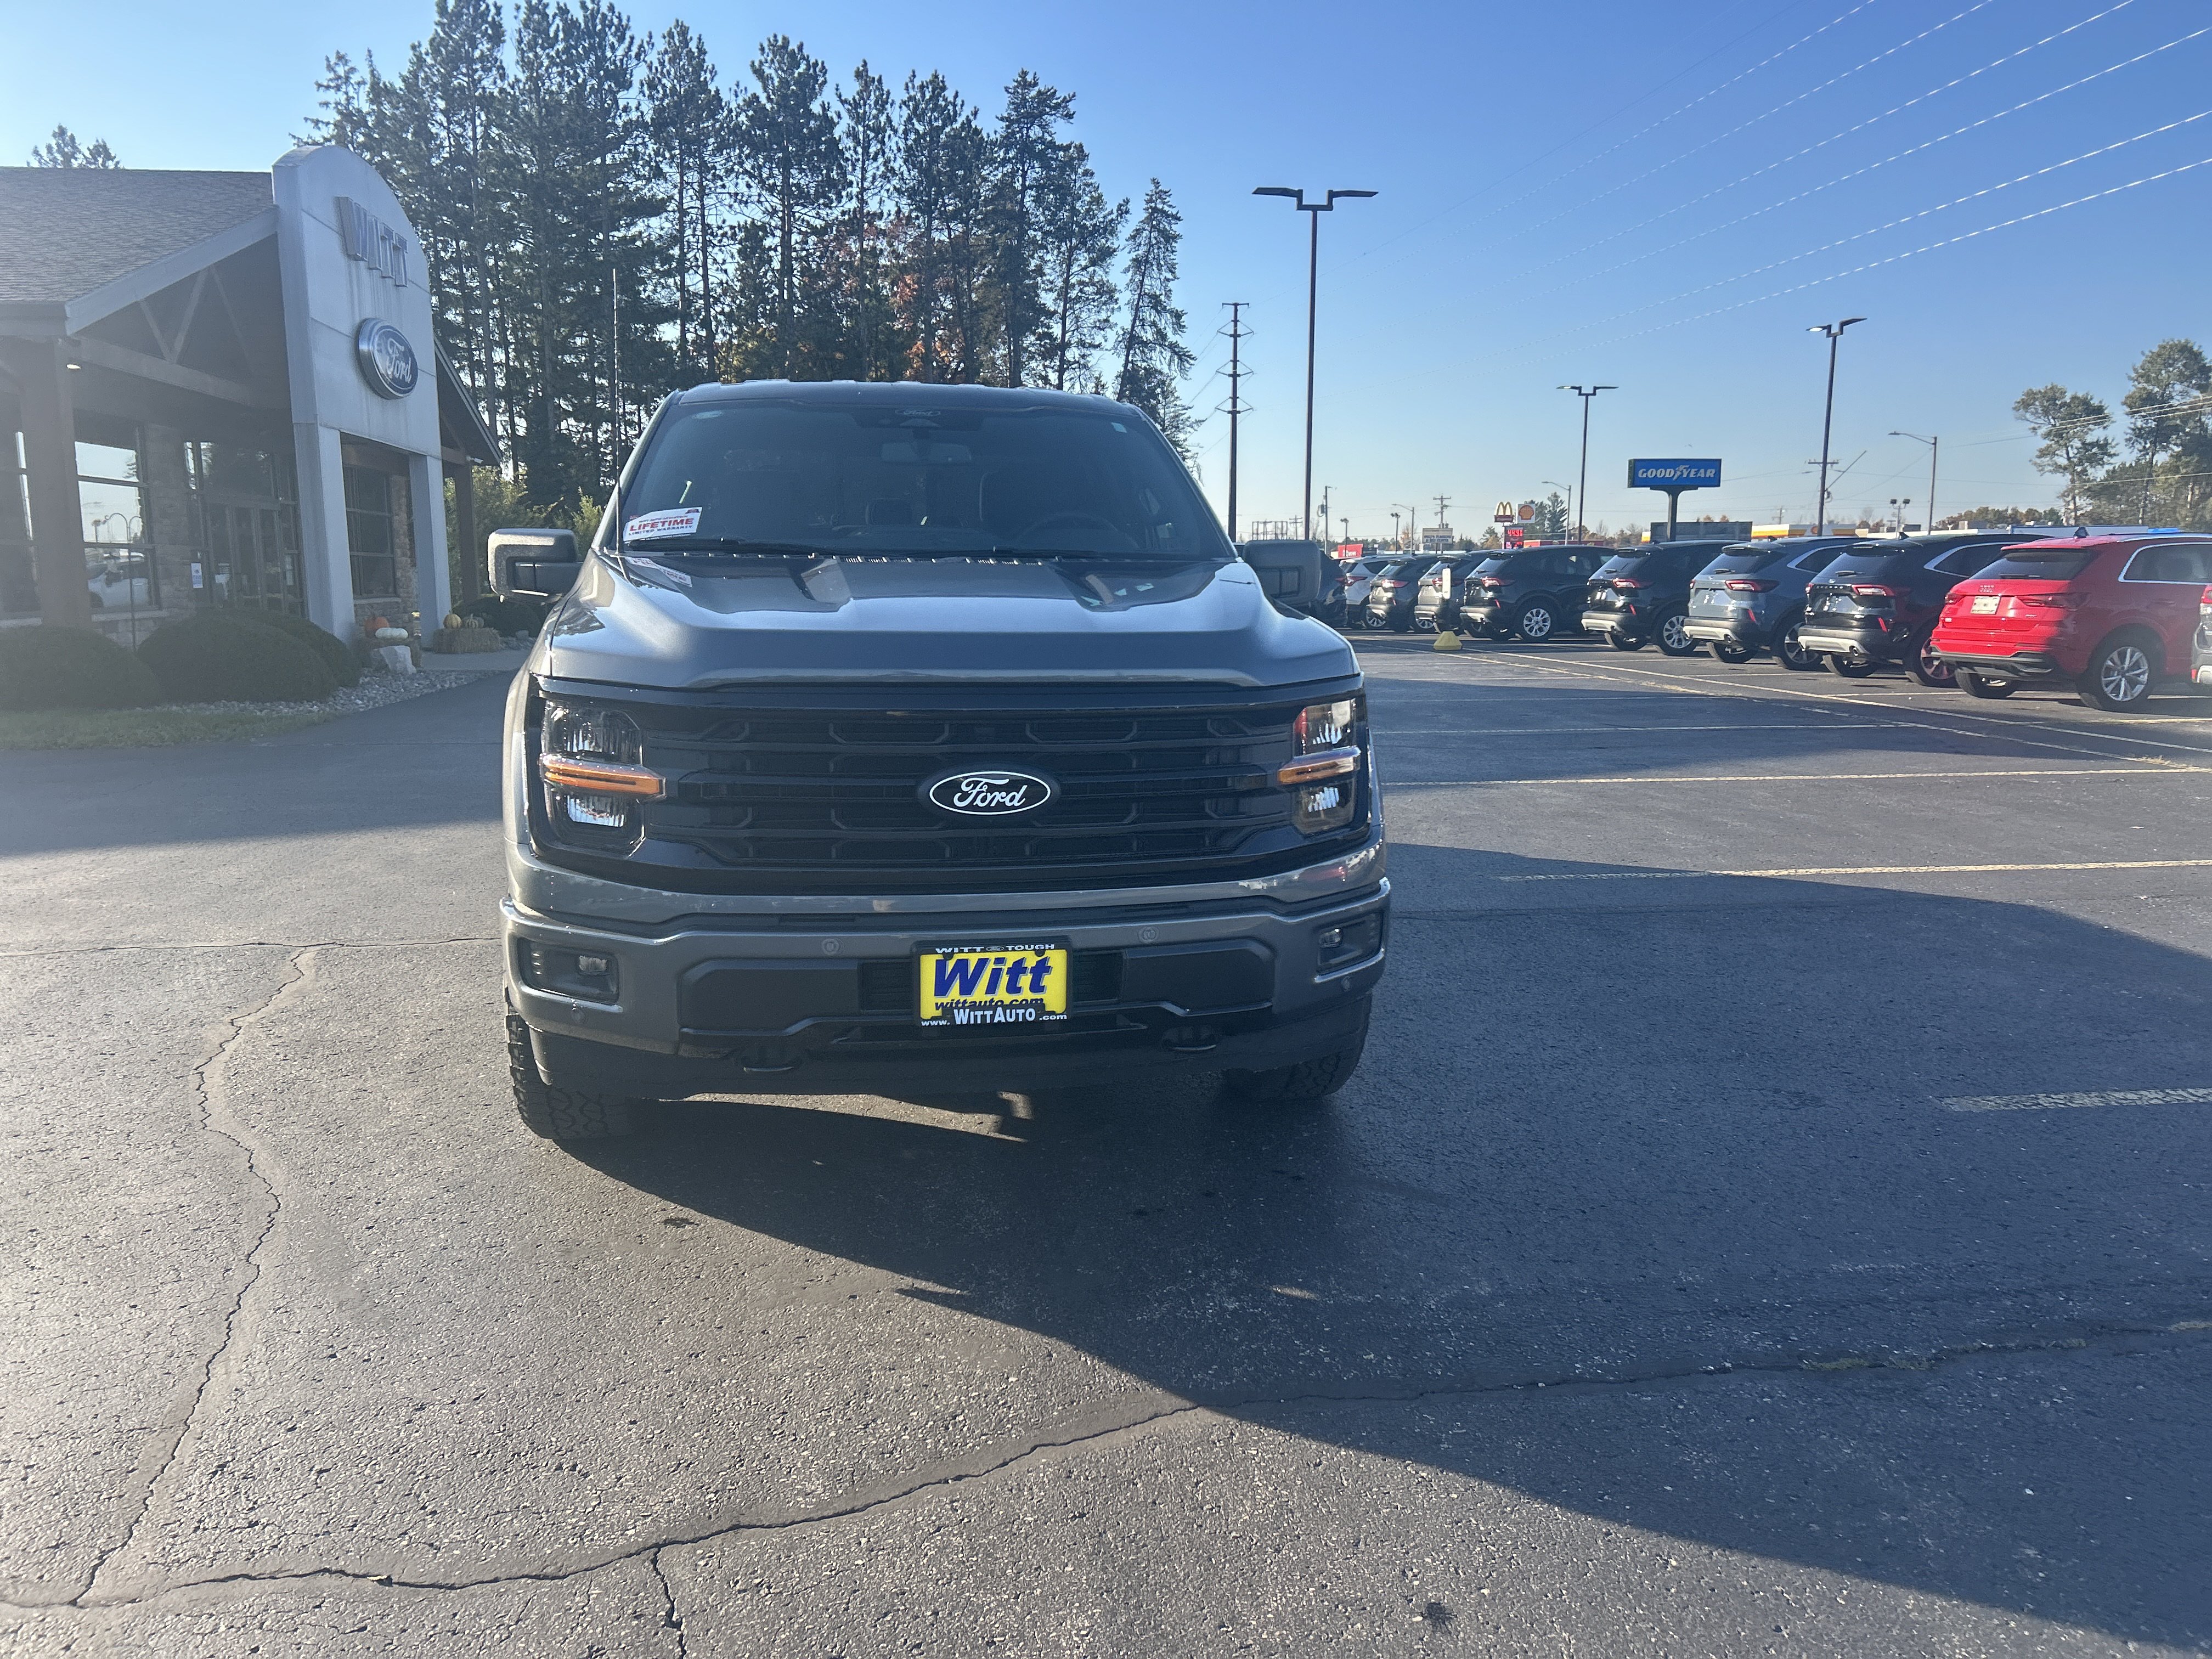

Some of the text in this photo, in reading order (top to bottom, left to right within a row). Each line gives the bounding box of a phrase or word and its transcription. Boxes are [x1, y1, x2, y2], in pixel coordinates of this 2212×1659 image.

[334, 196, 408, 287] WITT
[386, 337, 413, 383] Ford
[1638, 466, 1716, 481] GOODYEAR
[629, 518, 694, 531] LIFETIME
[953, 777, 1028, 807] Ford
[934, 956, 1053, 997] Witt
[935, 997, 1043, 1011] wittautocom
